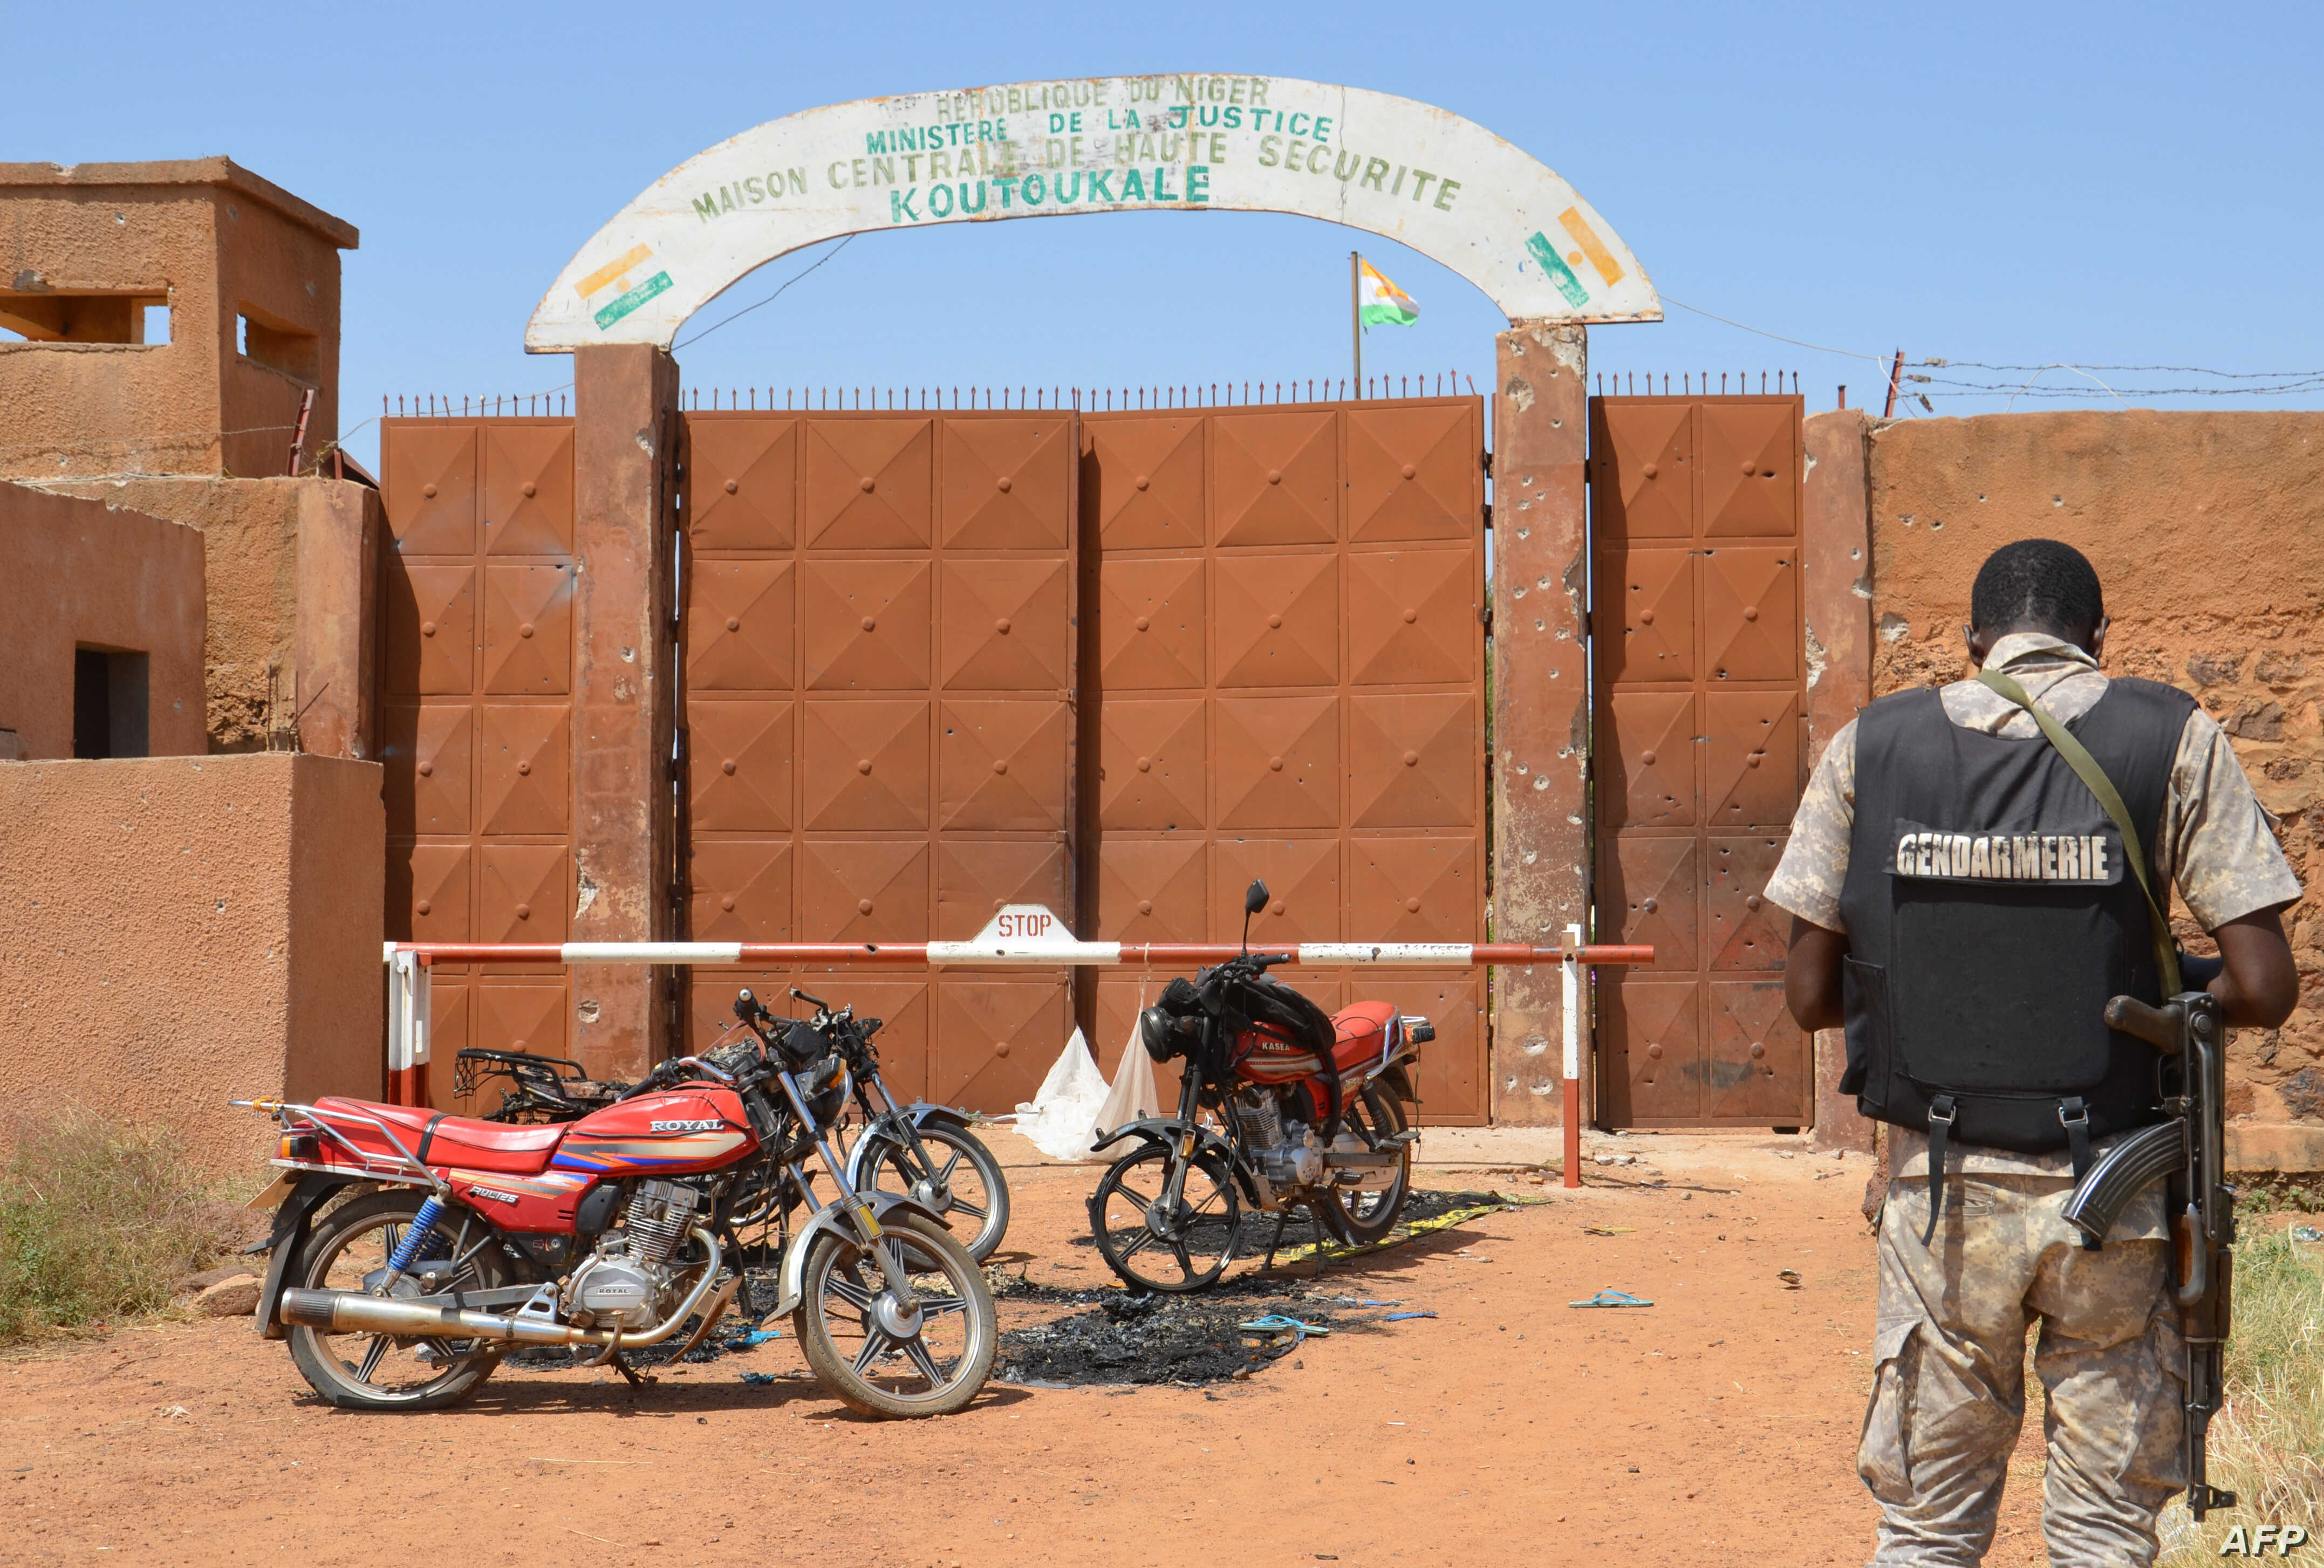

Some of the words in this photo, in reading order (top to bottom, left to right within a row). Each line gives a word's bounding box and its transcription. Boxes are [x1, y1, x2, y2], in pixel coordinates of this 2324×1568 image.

[1130, 78, 1160, 103] DU
[1175, 77, 1269, 105] NIGER
[866, 118, 1007, 155] MINISTERE
[1049, 112, 1082, 134] DE
[1109, 109, 1141, 130] LA
[1168, 106, 1334, 142] JUSTICE
[691, 167, 808, 223] MAISON
[828, 141, 1020, 189] CENTRALE
[1045, 136, 1085, 169] DE
[1113, 132, 1227, 164] HAUTE
[1258, 135, 1461, 212] SECURITE
[890, 166, 1209, 223] KOUTOUKALE
[1896, 833, 2109, 880] GENDARMERIE
[999, 914, 1051, 937] STOP
[1261, 1042, 1290, 1051] KASEA
[650, 1119, 725, 1132] ROYAL
